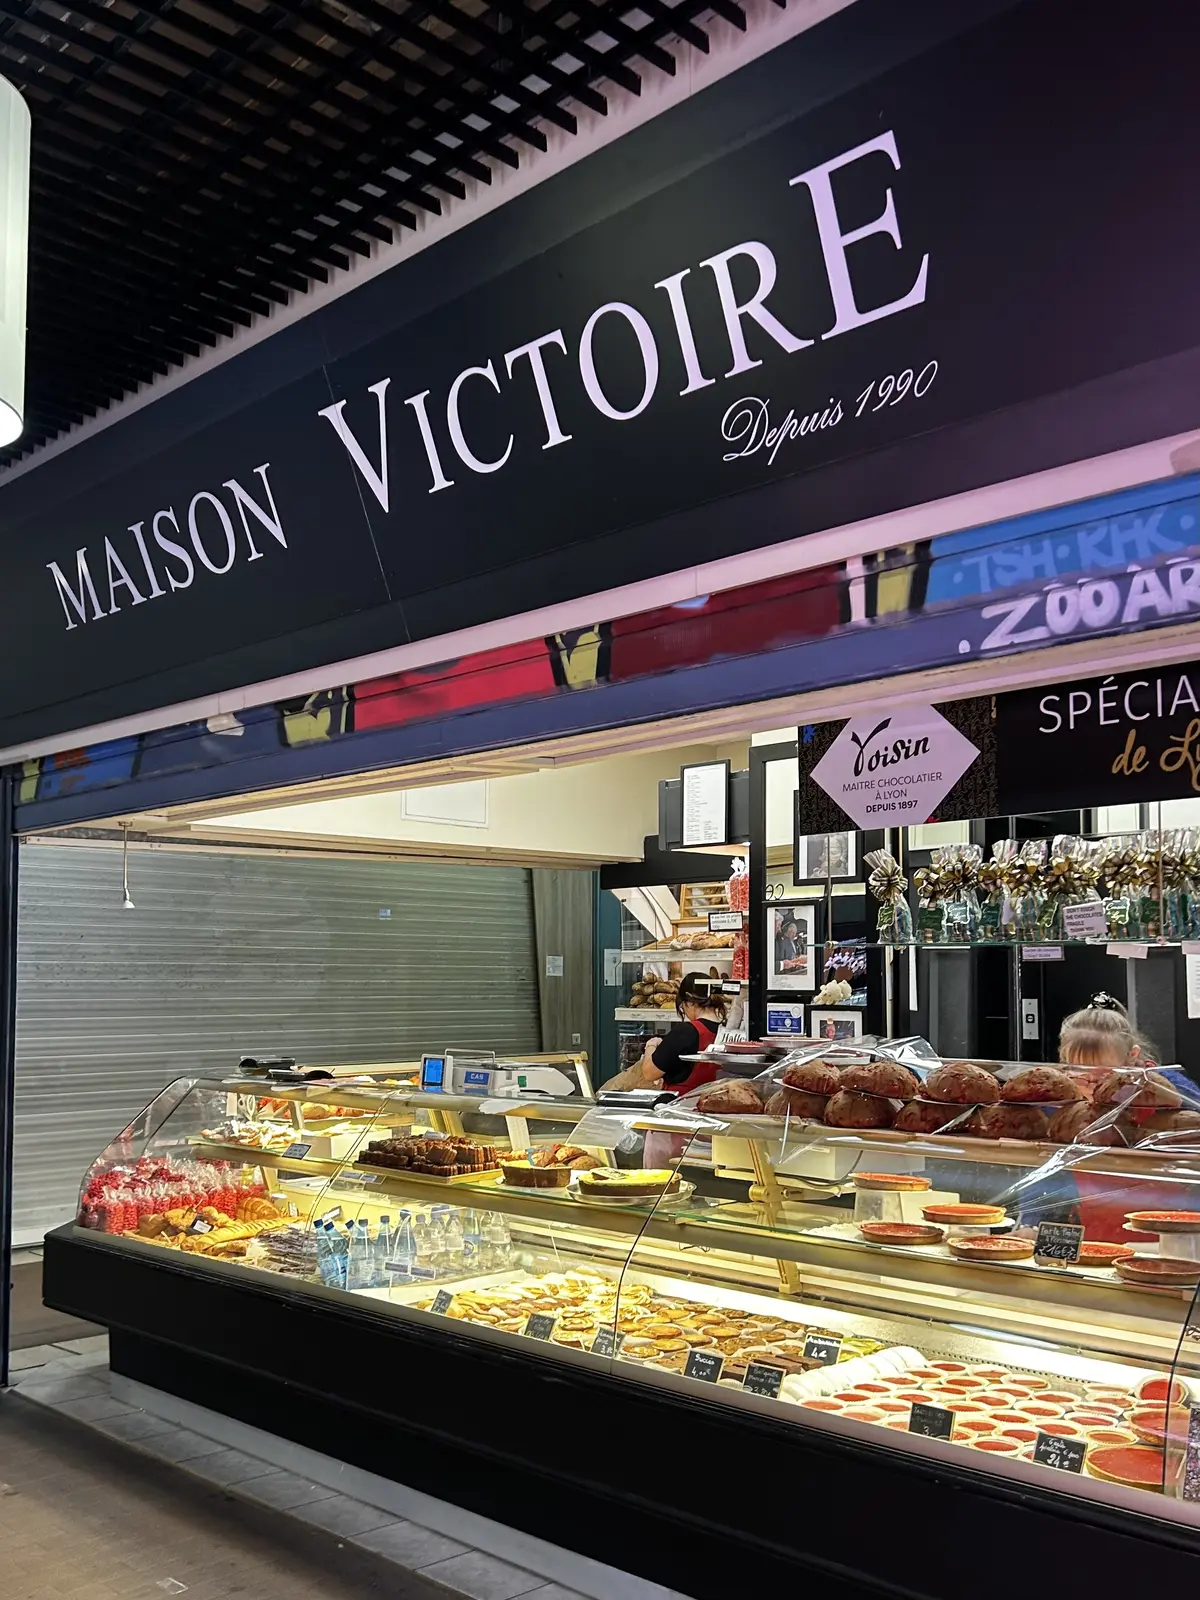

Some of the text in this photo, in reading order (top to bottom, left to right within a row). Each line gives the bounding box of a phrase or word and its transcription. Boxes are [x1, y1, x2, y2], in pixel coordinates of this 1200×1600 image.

[46, 130, 930, 631] MAISON VICTOIRE
[721, 360, 939, 466] Depuis 1990
[851, 717, 931, 777] Voisin
[1111, 729, 1149, 776] de
[877, 771, 942, 788] CHOCOLATIER
[884, 789, 907, 800] LYON
[866, 800, 918, 813] DEPUIS 1897
